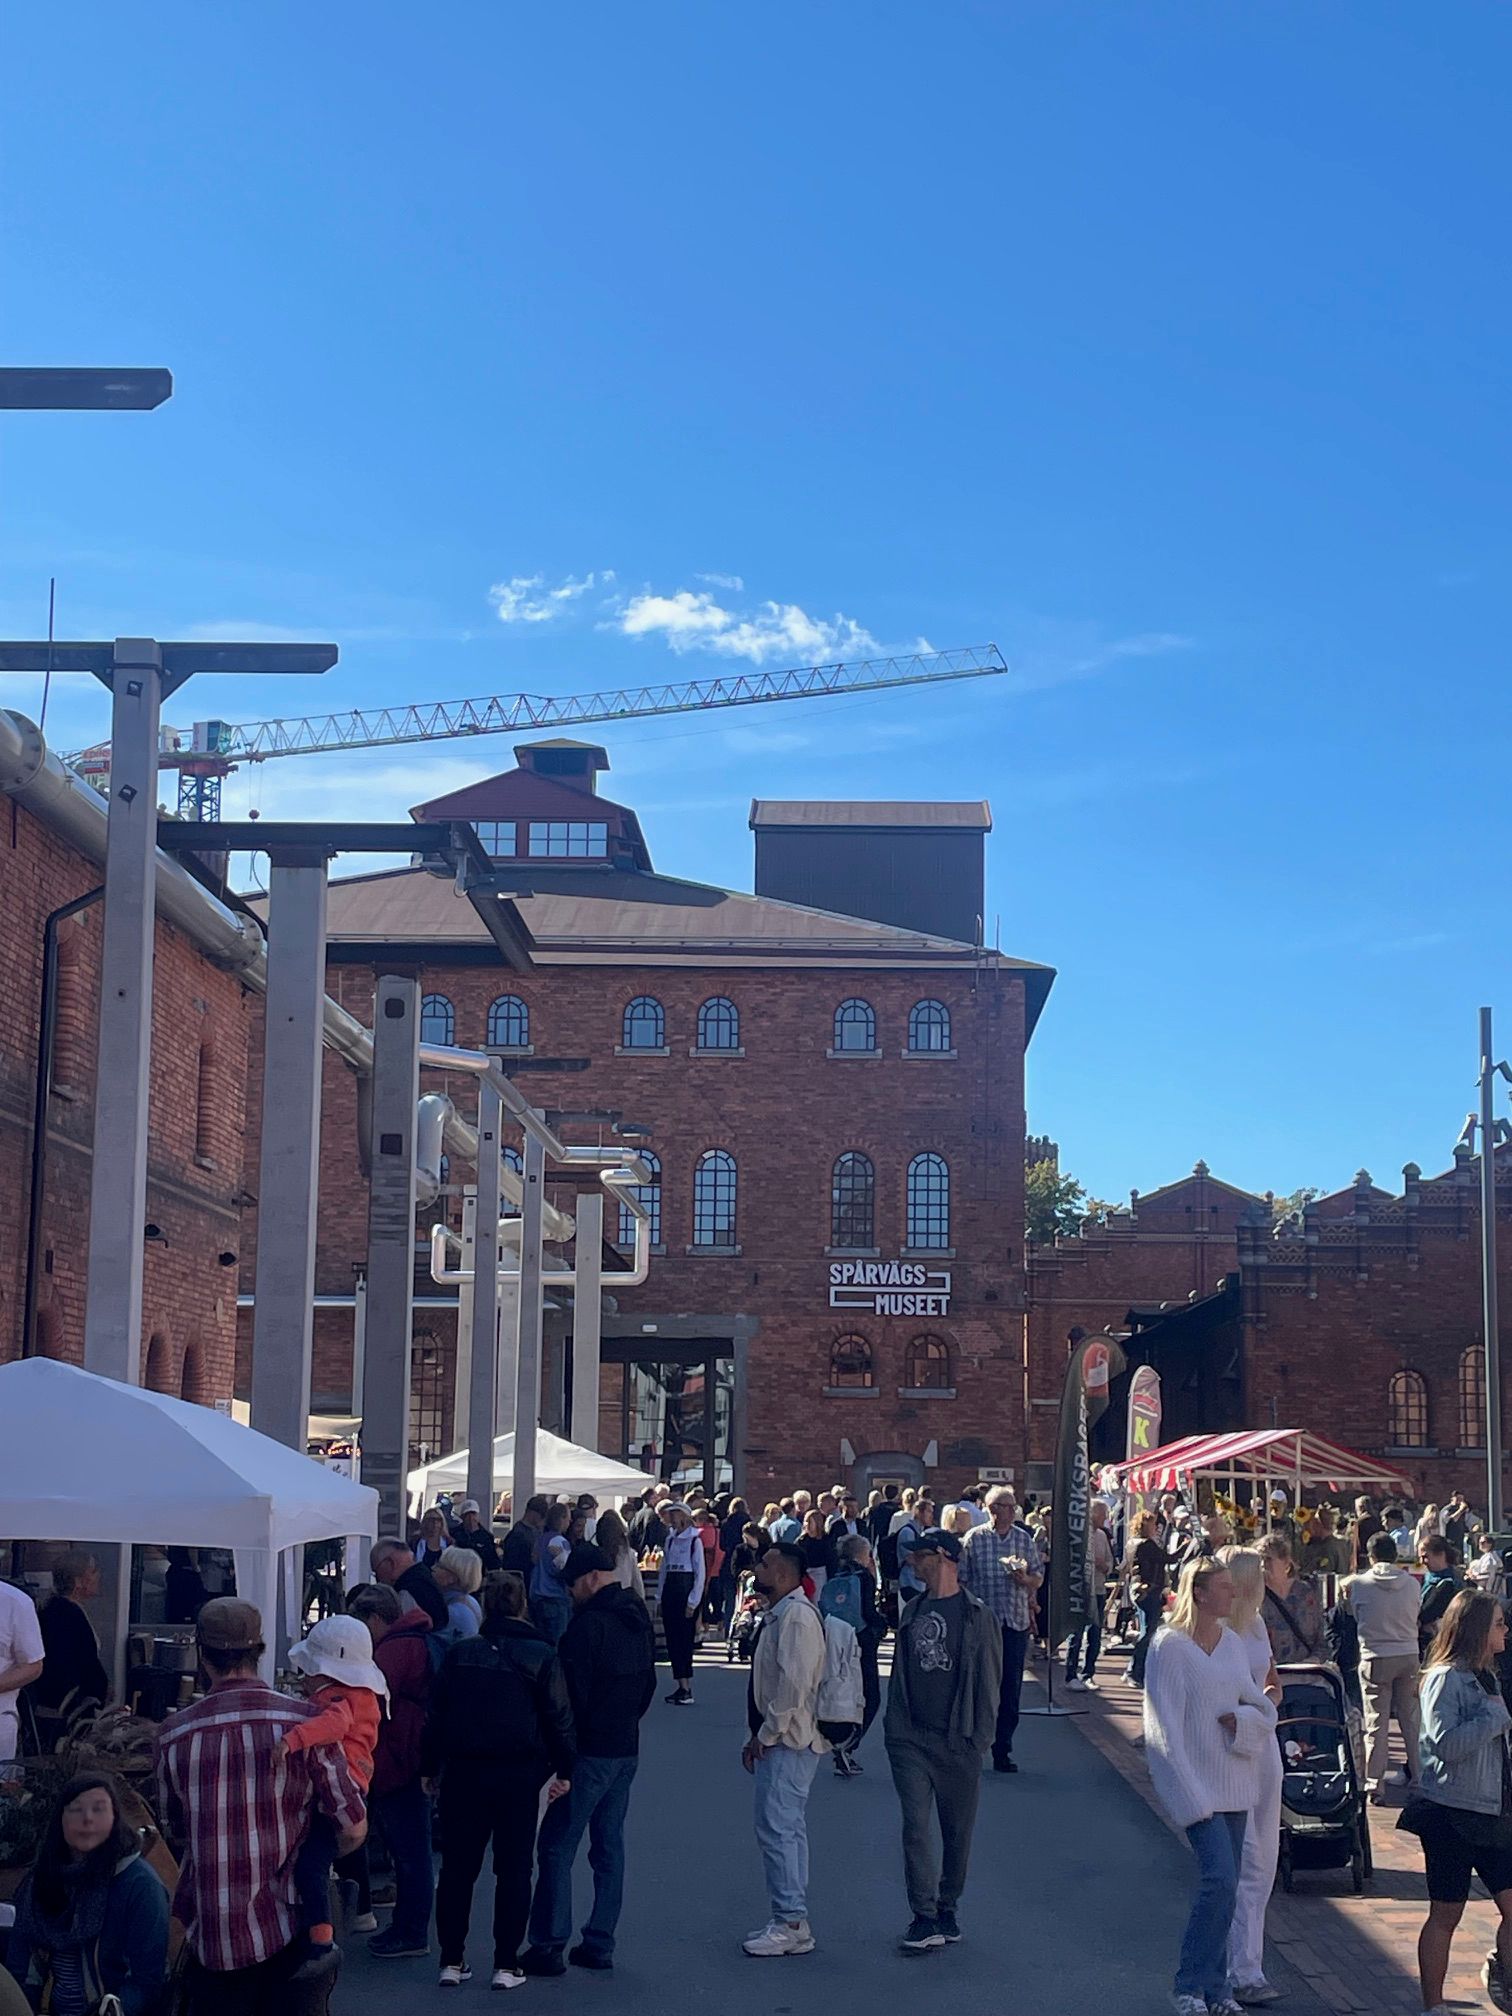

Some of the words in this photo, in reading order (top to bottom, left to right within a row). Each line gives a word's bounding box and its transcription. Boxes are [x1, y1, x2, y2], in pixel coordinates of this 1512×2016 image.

[829, 1259, 926, 1285] SPÅRVÄGS
[875, 1294, 951, 1316] MUSEET
[1068, 1386, 1088, 1614] HANTVERKSBAGE
